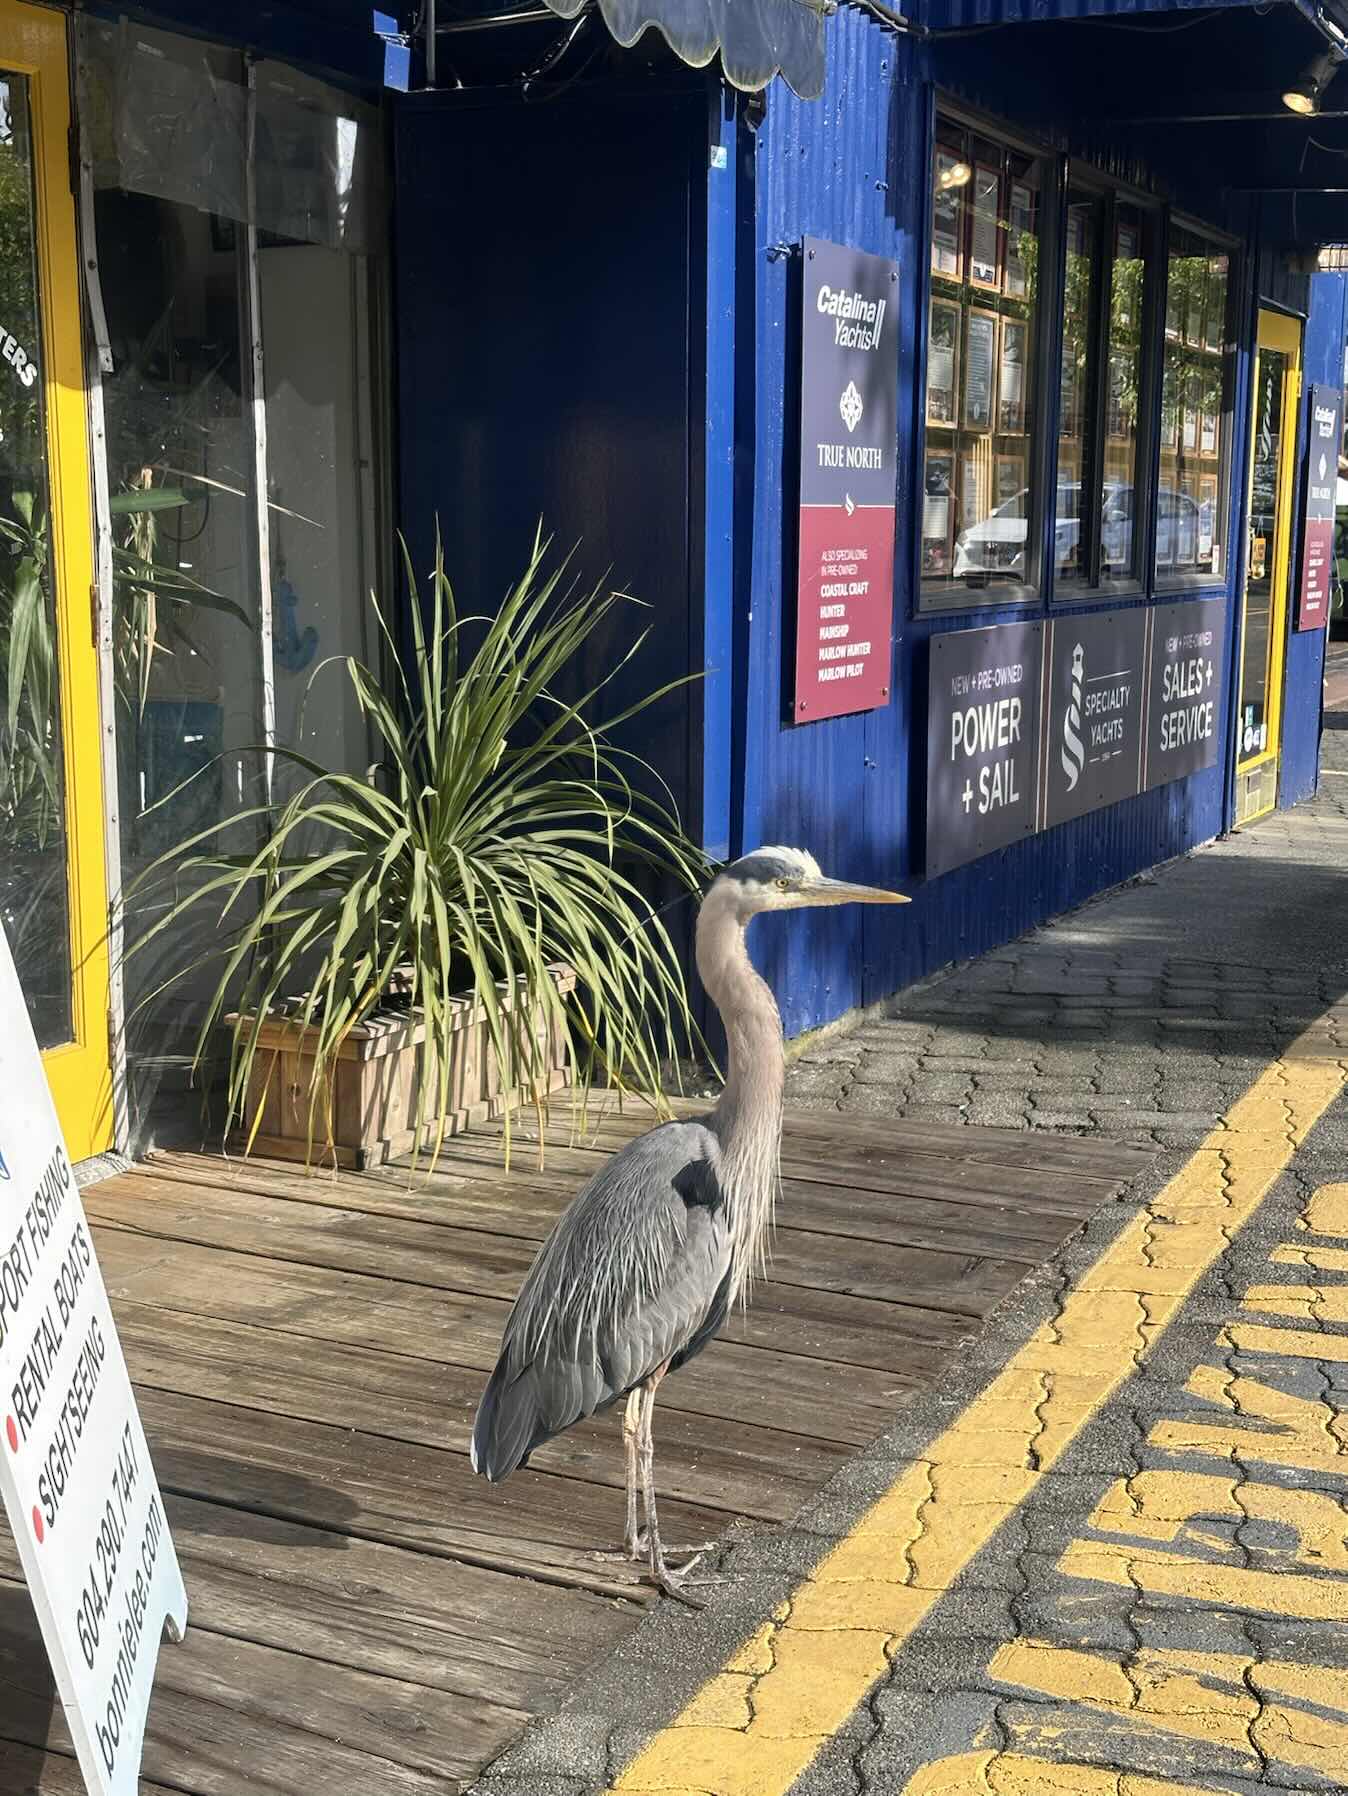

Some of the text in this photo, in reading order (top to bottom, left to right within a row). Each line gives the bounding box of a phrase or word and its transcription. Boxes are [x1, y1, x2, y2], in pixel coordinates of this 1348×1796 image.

[817, 285, 876, 323] Catalina
[834, 318, 873, 350] Yachts
[817, 444, 882, 469] TRUE NORTH
[820, 581, 869, 598] COASTAL CRAFT
[820, 604, 845, 619] HUNTER
[819, 625, 849, 640] MAINSHIP
[818, 642, 871, 661] MARLOW HUNTER
[818, 663, 864, 682] MARLOW PILOT
[951, 672, 970, 697] NEW
[977, 664, 1023, 691] PRE-OWNED
[1085, 686, 1131, 717] SPECIALTY
[951, 697, 1022, 761] POWER
[1090, 718, 1123, 747] YACHTS
[1160, 701, 1213, 751] SERVICE
[978, 758, 1020, 815] SAIL
[0, 1145, 70, 1349] PORT FISHING
[11, 1222, 91, 1441] RENTAL BOATS
[38, 1315, 105, 1529] SIGHTSEEING
[77, 1419, 139, 1671] 604.290.7447
[95, 1494, 162, 1779] bonnielee.com
